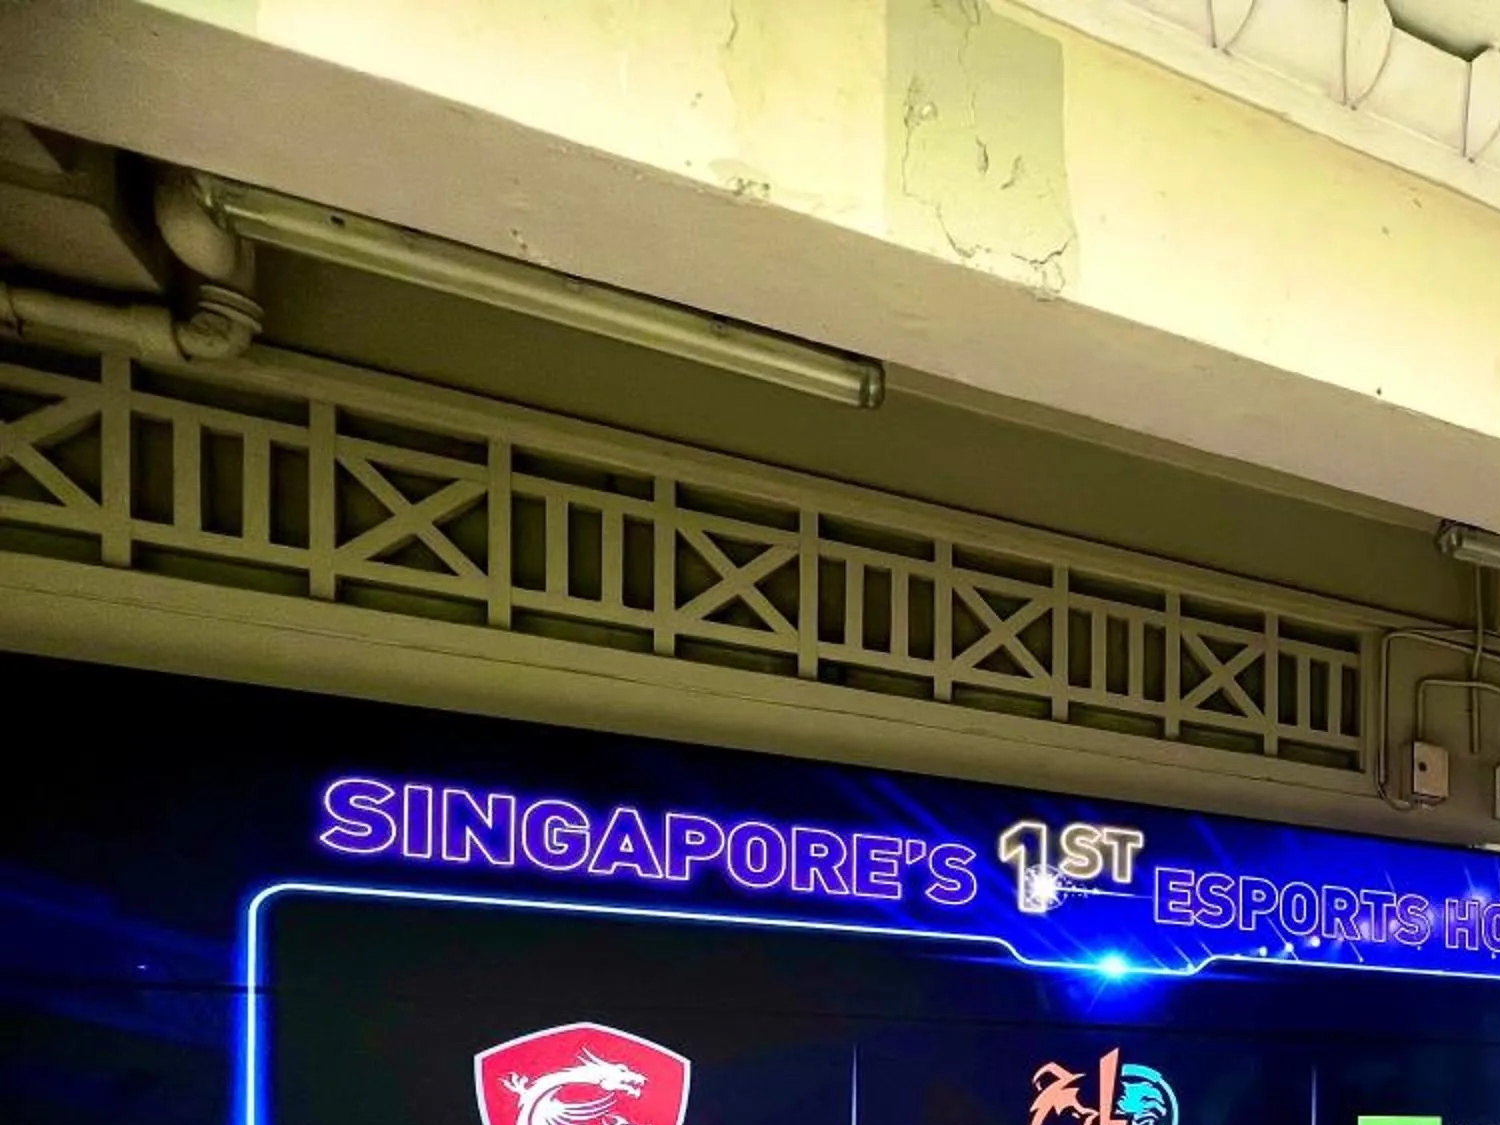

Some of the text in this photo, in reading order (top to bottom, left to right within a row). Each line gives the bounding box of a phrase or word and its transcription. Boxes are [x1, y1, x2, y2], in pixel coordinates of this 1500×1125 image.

[320, 778, 978, 905] SINGAPORE'S
[999, 821, 1144, 913] 1ST
[1154, 867, 1432, 945] ESPORTS
